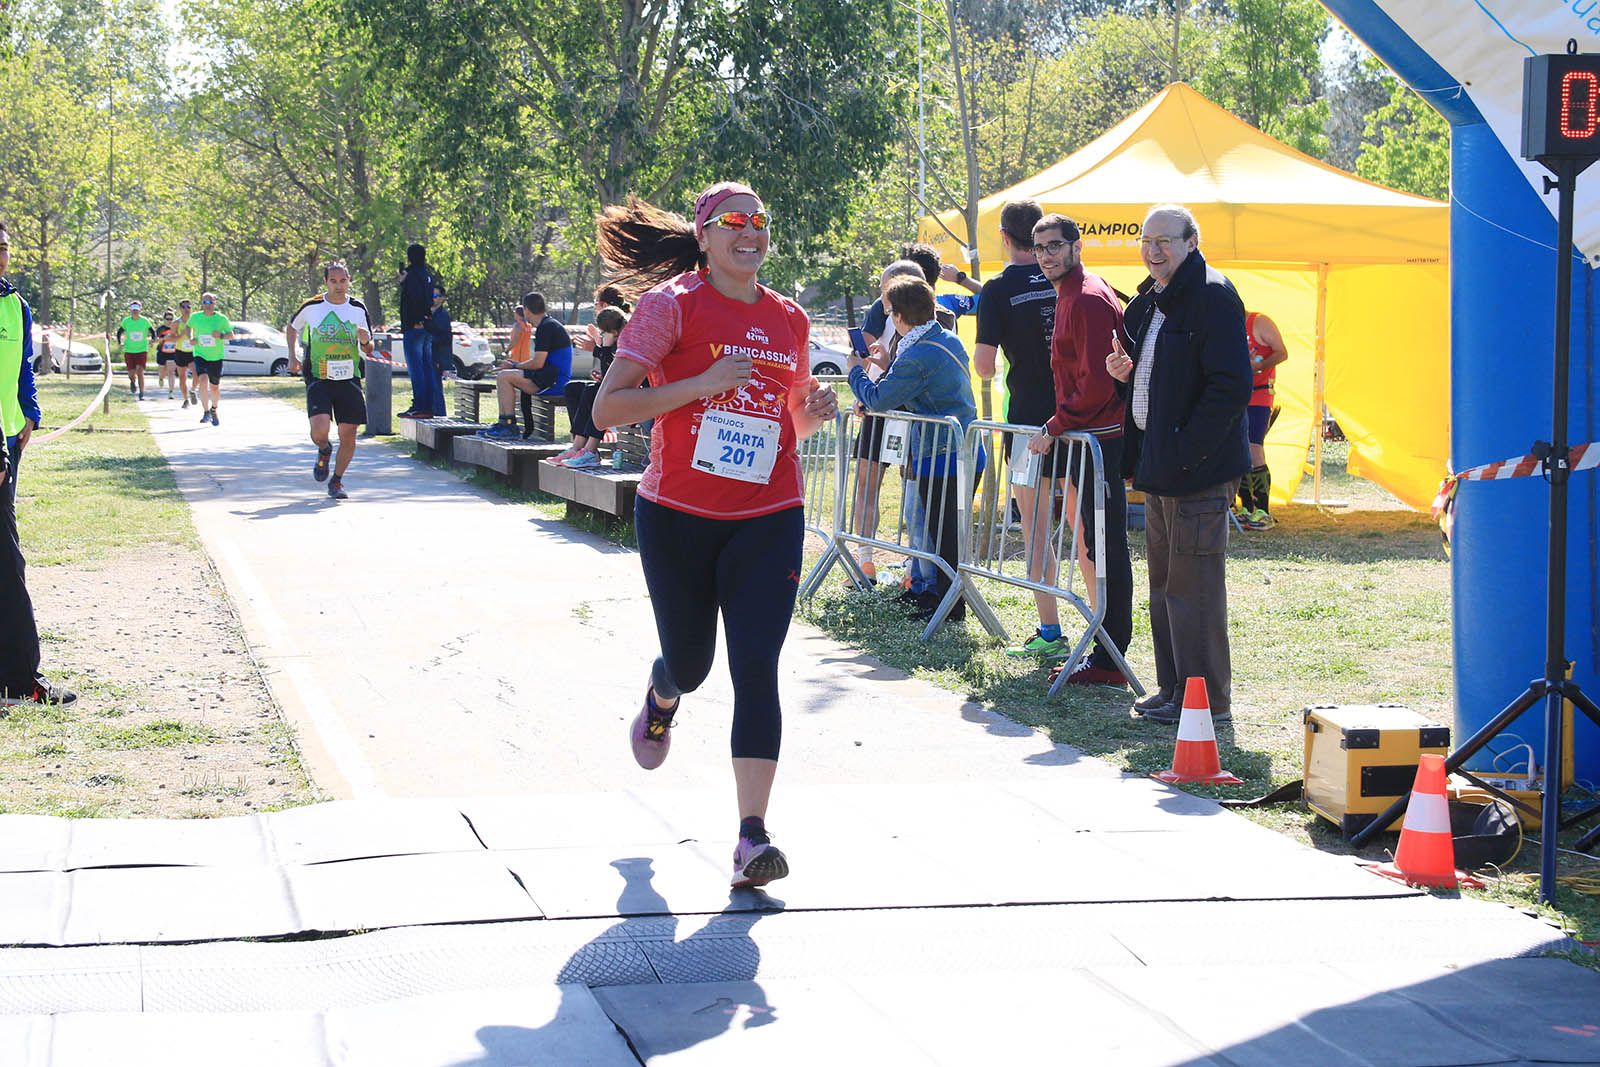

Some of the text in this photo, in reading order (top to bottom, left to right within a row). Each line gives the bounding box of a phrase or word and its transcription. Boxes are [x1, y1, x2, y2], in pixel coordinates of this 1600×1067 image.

[709, 343, 723, 359] V
[706, 415, 745, 429] MEDIJOCS
[717, 428, 765, 449] MARTA
[719, 445, 756, 468] 201
